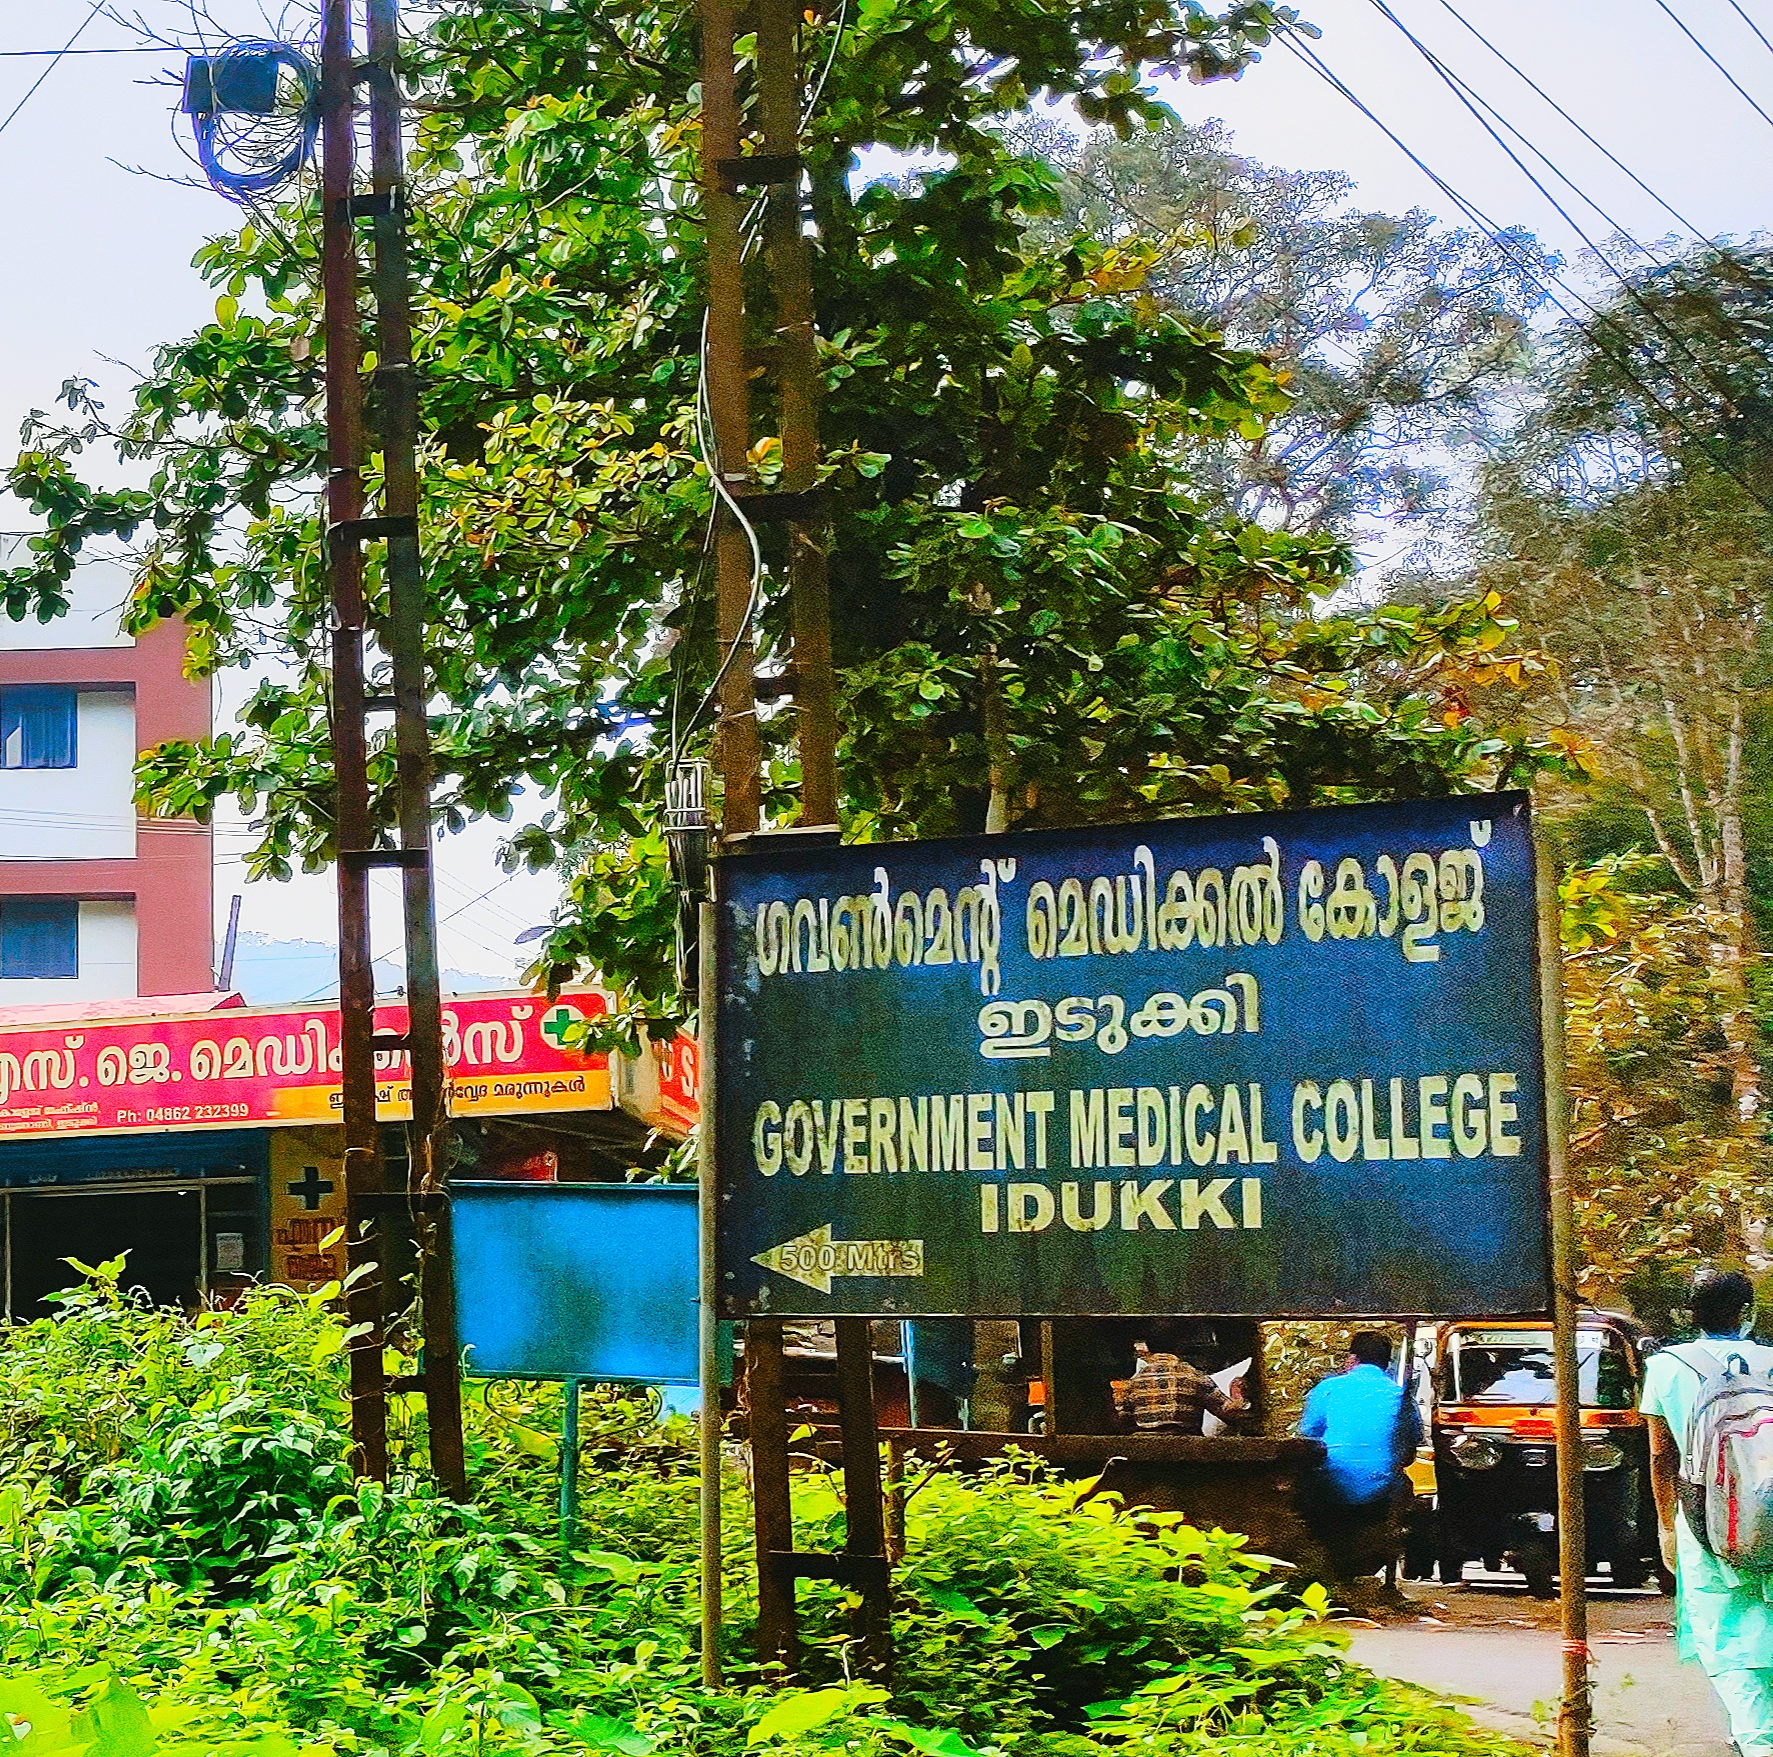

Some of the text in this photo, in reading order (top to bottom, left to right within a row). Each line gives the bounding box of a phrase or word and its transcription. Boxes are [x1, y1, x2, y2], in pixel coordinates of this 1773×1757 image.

[1027, 836, 1284, 959] മെഡിക്കൽ
[1299, 820, 1492, 962] കോളജ്
[979, 973, 1260, 1059] ഇടുക്കി
[117, 1103, 249, 1123] Ph: 04862 232399
[494, 1076, 585, 1099] മരുന്നുകൾ
[753, 1073, 1521, 1177] GOVERNMENT MEDICAL COLLEGE
[980, 1177, 1262, 1233] IDUKKI
[780, 1244, 920, 1271] 500 Mtrs
